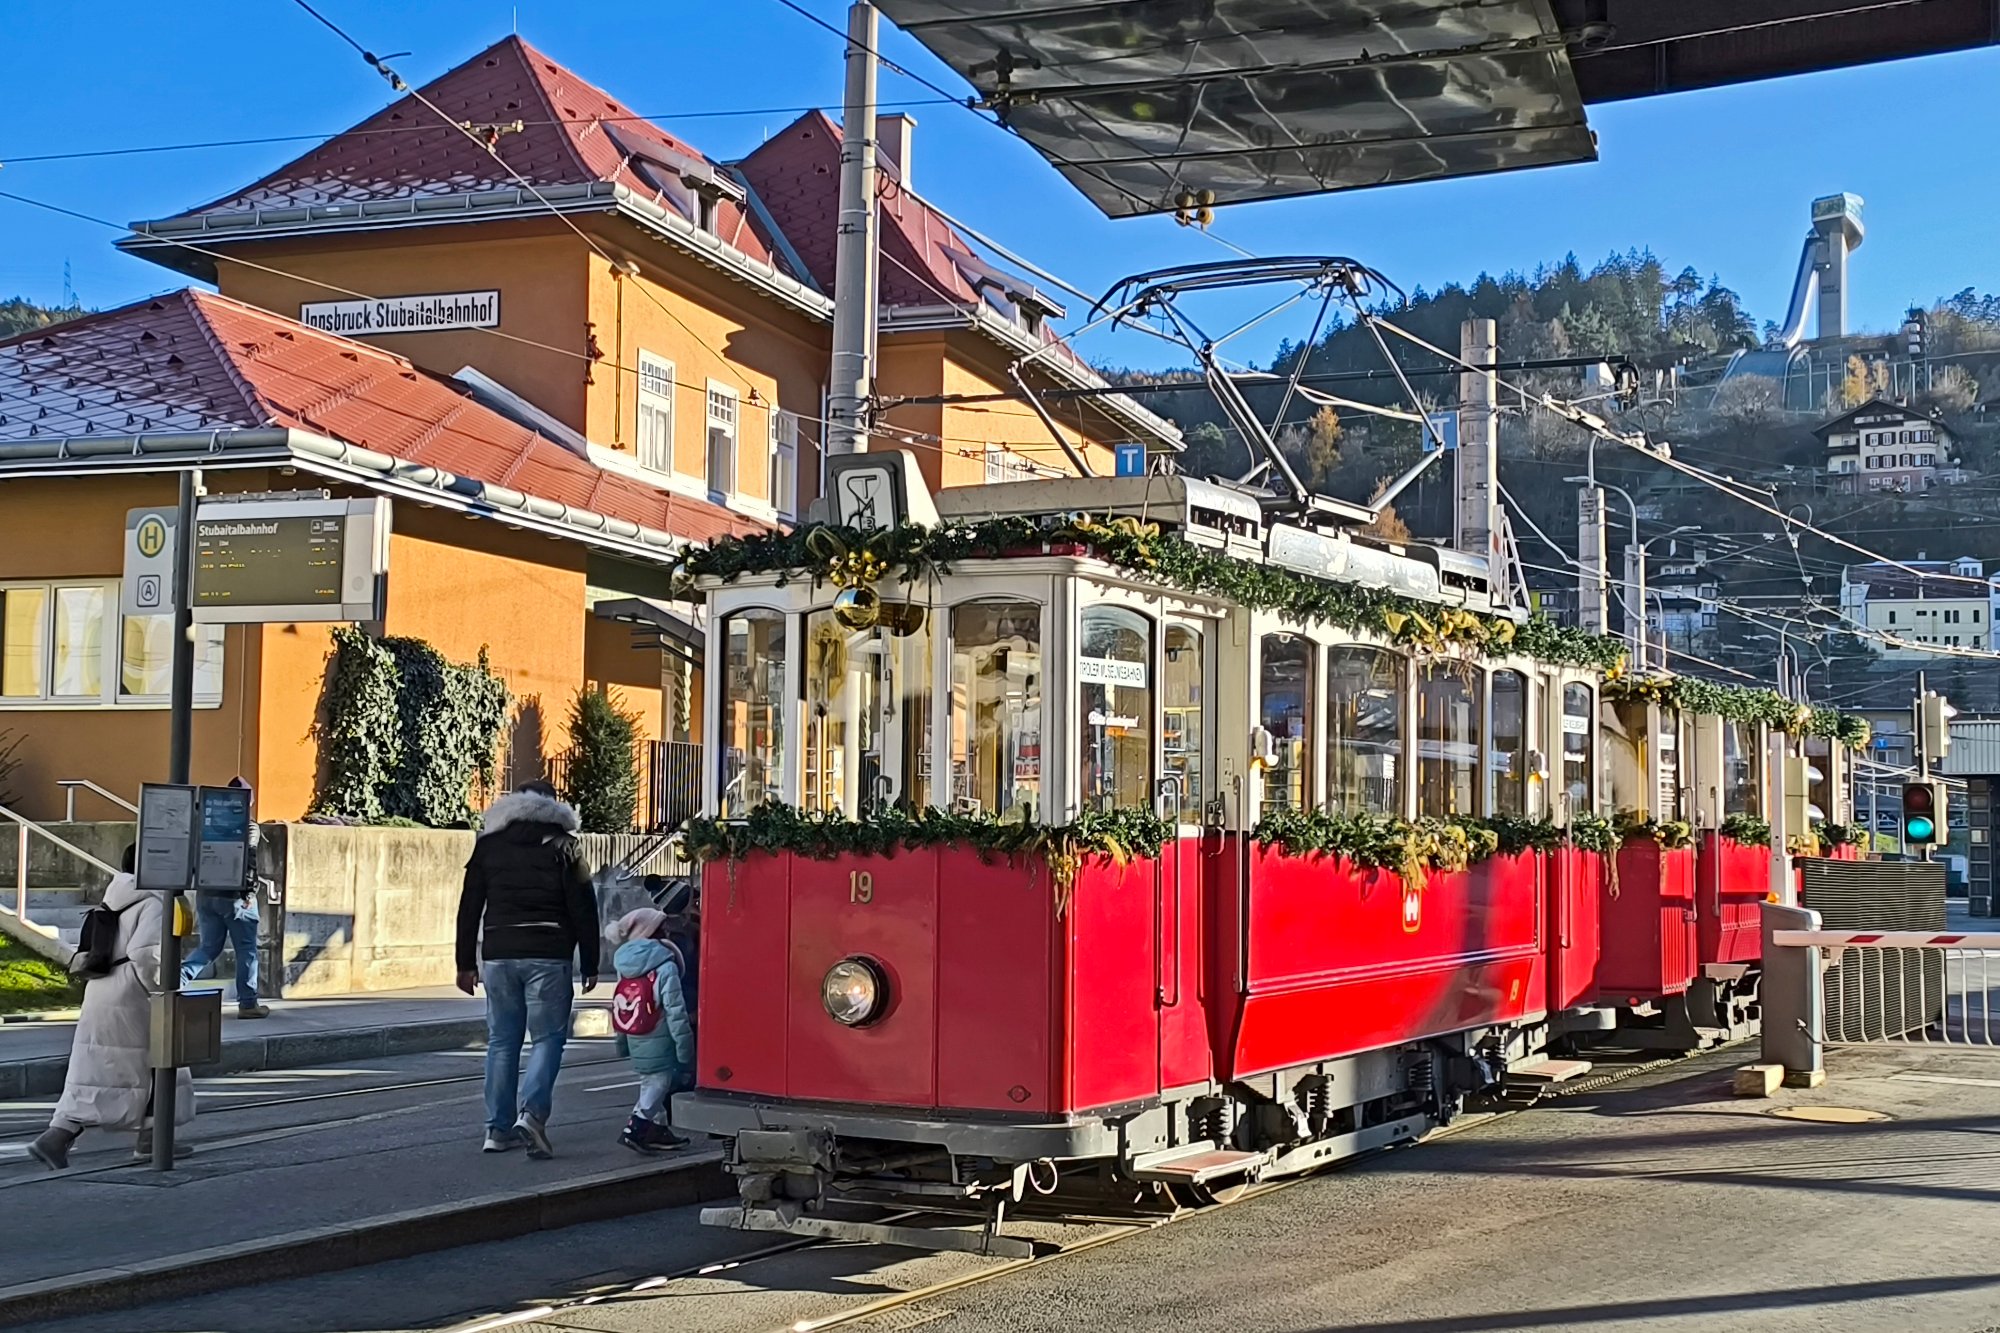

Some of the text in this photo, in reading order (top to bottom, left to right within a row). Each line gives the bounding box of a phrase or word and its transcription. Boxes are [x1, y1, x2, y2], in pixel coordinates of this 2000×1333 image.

[1121, 448, 1139, 473] T
[144, 526, 158, 550] H
[198, 522, 279, 537] Stubaitalbahnhof
[849, 870, 873, 904] 19
